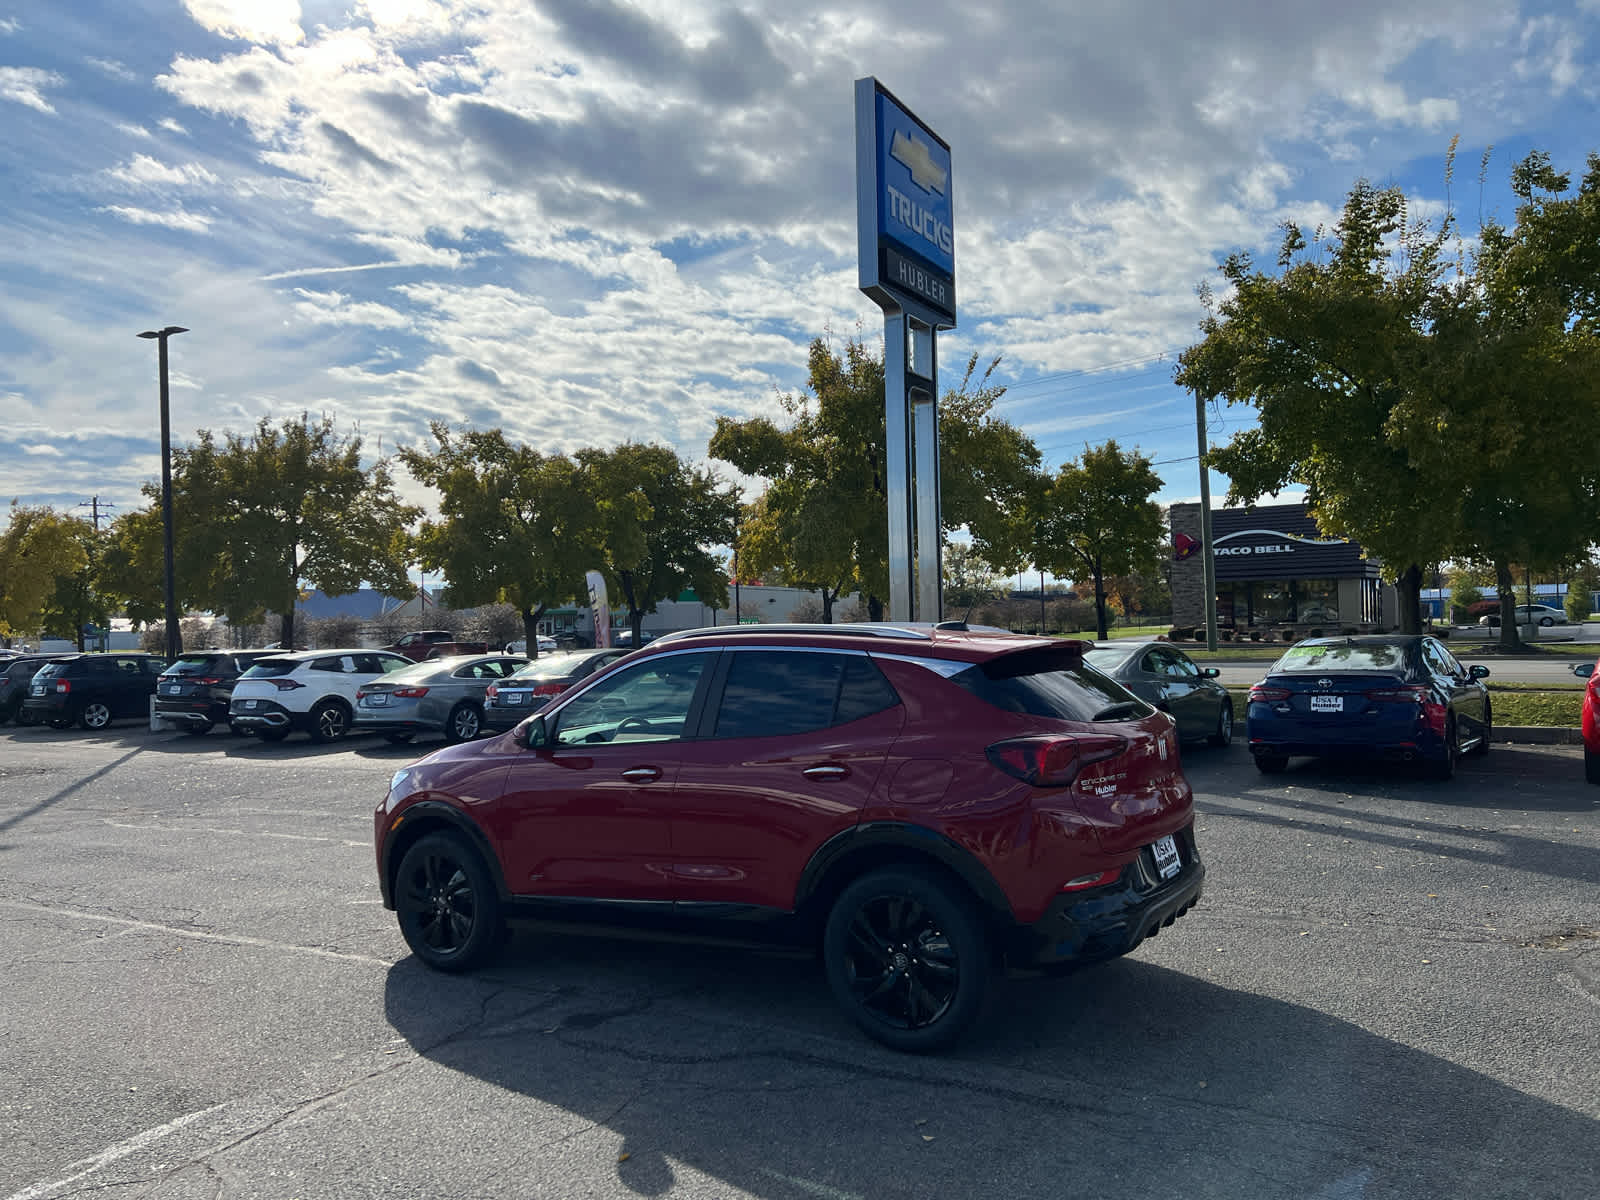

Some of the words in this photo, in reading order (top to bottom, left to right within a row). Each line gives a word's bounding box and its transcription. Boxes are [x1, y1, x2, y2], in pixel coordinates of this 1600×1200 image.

[887, 184, 953, 255] TRUCKS
[899, 259, 945, 304] HUBLER
[1213, 547, 1252, 555] TACO
[1255, 545, 1295, 553] BELL
[1095, 784, 1117, 795] Hubler
